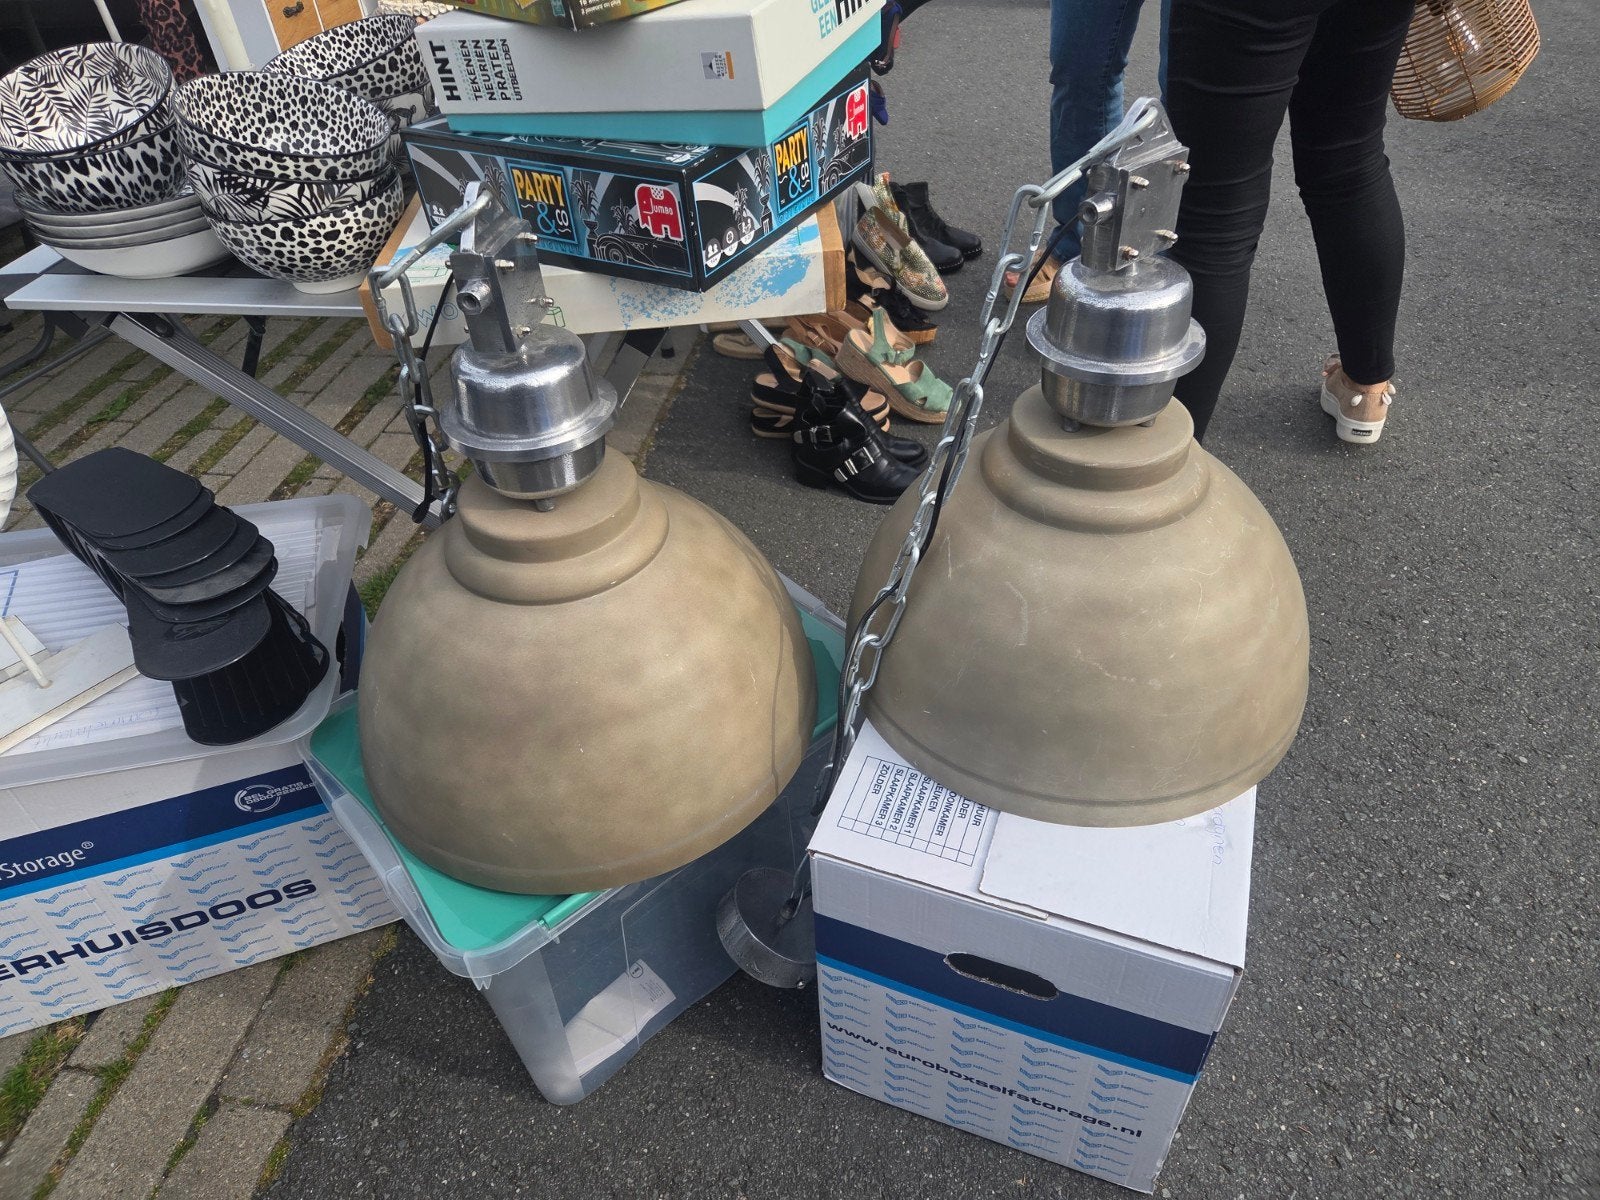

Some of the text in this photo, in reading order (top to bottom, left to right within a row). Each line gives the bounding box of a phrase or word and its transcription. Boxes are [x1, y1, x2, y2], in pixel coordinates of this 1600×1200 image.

[818, 6, 837, 39] EEN
[429, 41, 461, 100] HINT
[458, 40, 483, 101] TEKENEN
[485, 39, 511, 100] PRATEN
[500, 39, 523, 100] UITBEELDEN
[775, 127, 808, 176] PARTY
[511, 169, 565, 207] PARTY
[789, 165, 803, 199] &
[536, 201, 560, 235] &
[872, 763, 890, 795] ZOLDER
[881, 768, 904, 820] SLAAPKAMER
[895, 772, 918, 825] SLAAPKAMER
[928, 782, 944, 812] EUKEN
[907, 776, 932, 830] SLAAPKAMER
[935, 790, 957, 837] OONKAMER
[958, 796, 971, 819] LDER
[972, 803, 986, 827] HUUR
[0, 841, 94, 881] Storage®
[826, 1021, 1142, 1138] www.euroboxselfstorage.nl
